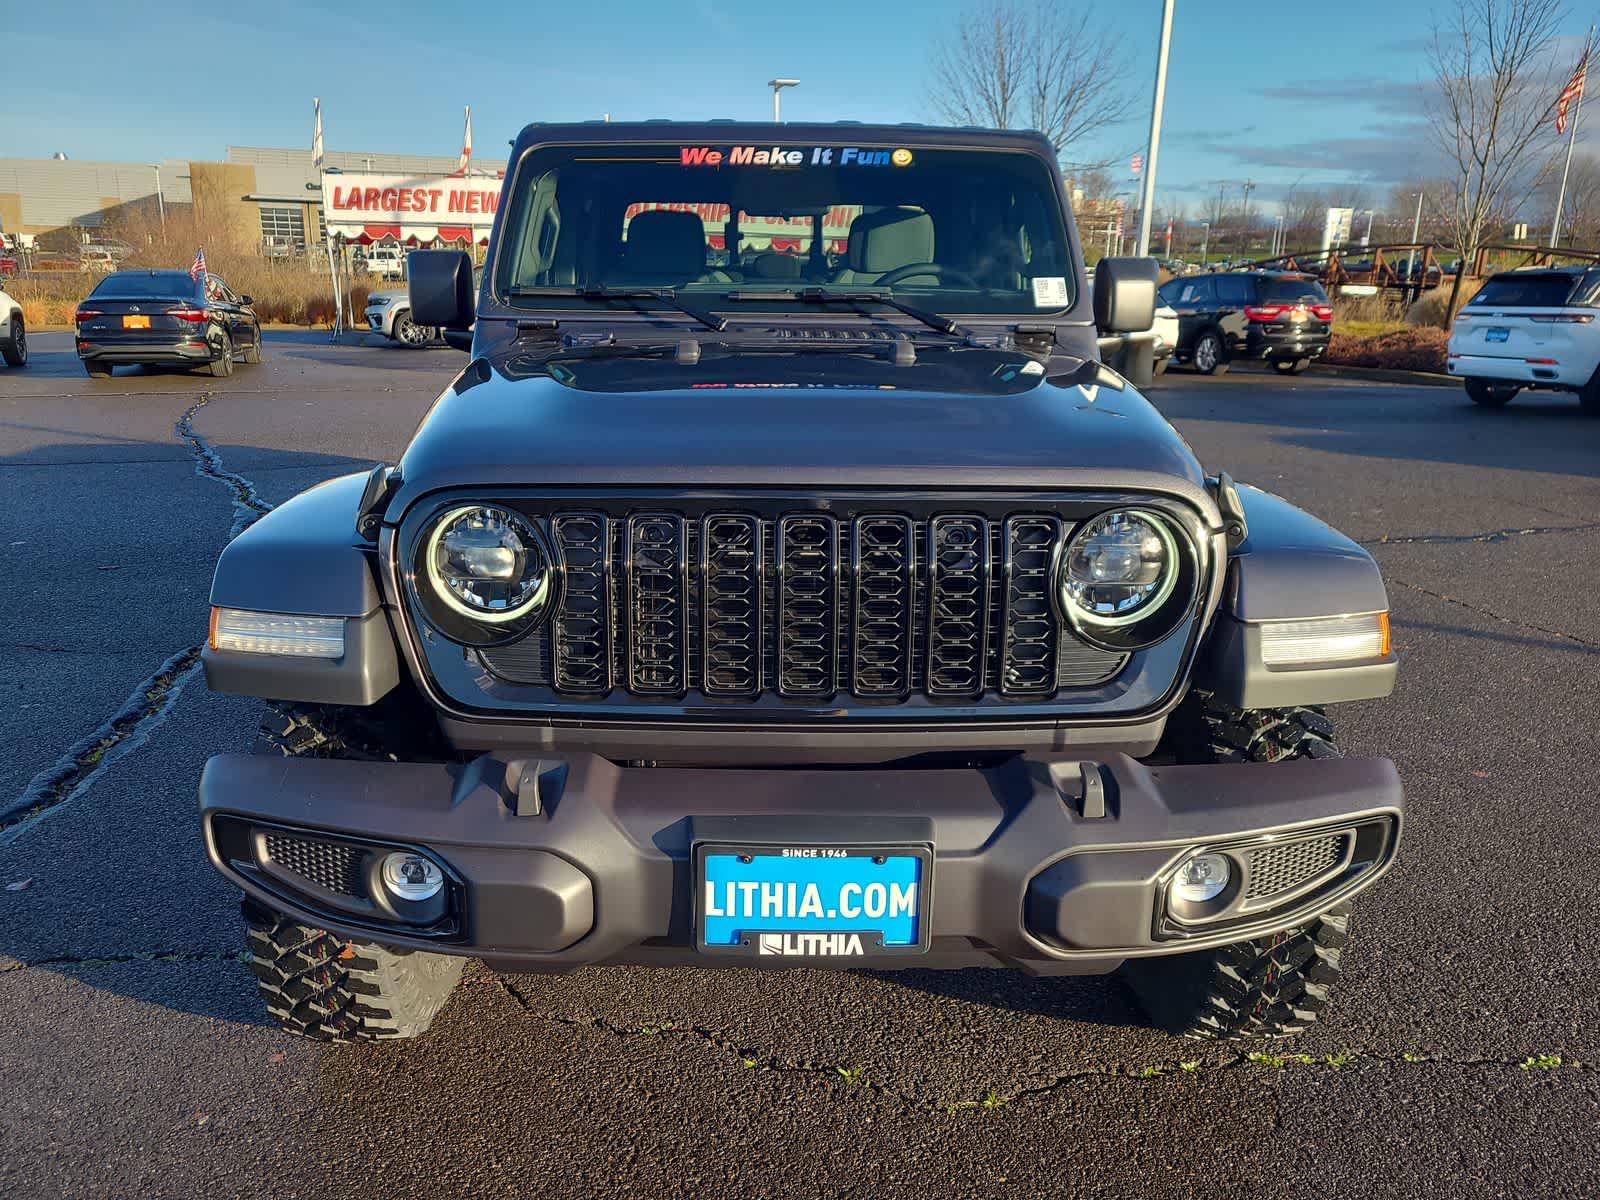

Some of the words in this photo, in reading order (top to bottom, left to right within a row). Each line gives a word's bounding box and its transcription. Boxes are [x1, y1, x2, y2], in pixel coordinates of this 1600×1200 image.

[681, 147, 722, 166] We
[729, 147, 803, 165] Make
[811, 148, 832, 165] It
[840, 148, 889, 165] Fun
[333, 186, 442, 212] LARGEST
[448, 190, 501, 213] NEW
[782, 848, 817, 858] SINCE
[820, 849, 848, 858] 1946
[705, 880, 918, 919] LITHIA.COM
[783, 934, 864, 956] LITHIA
